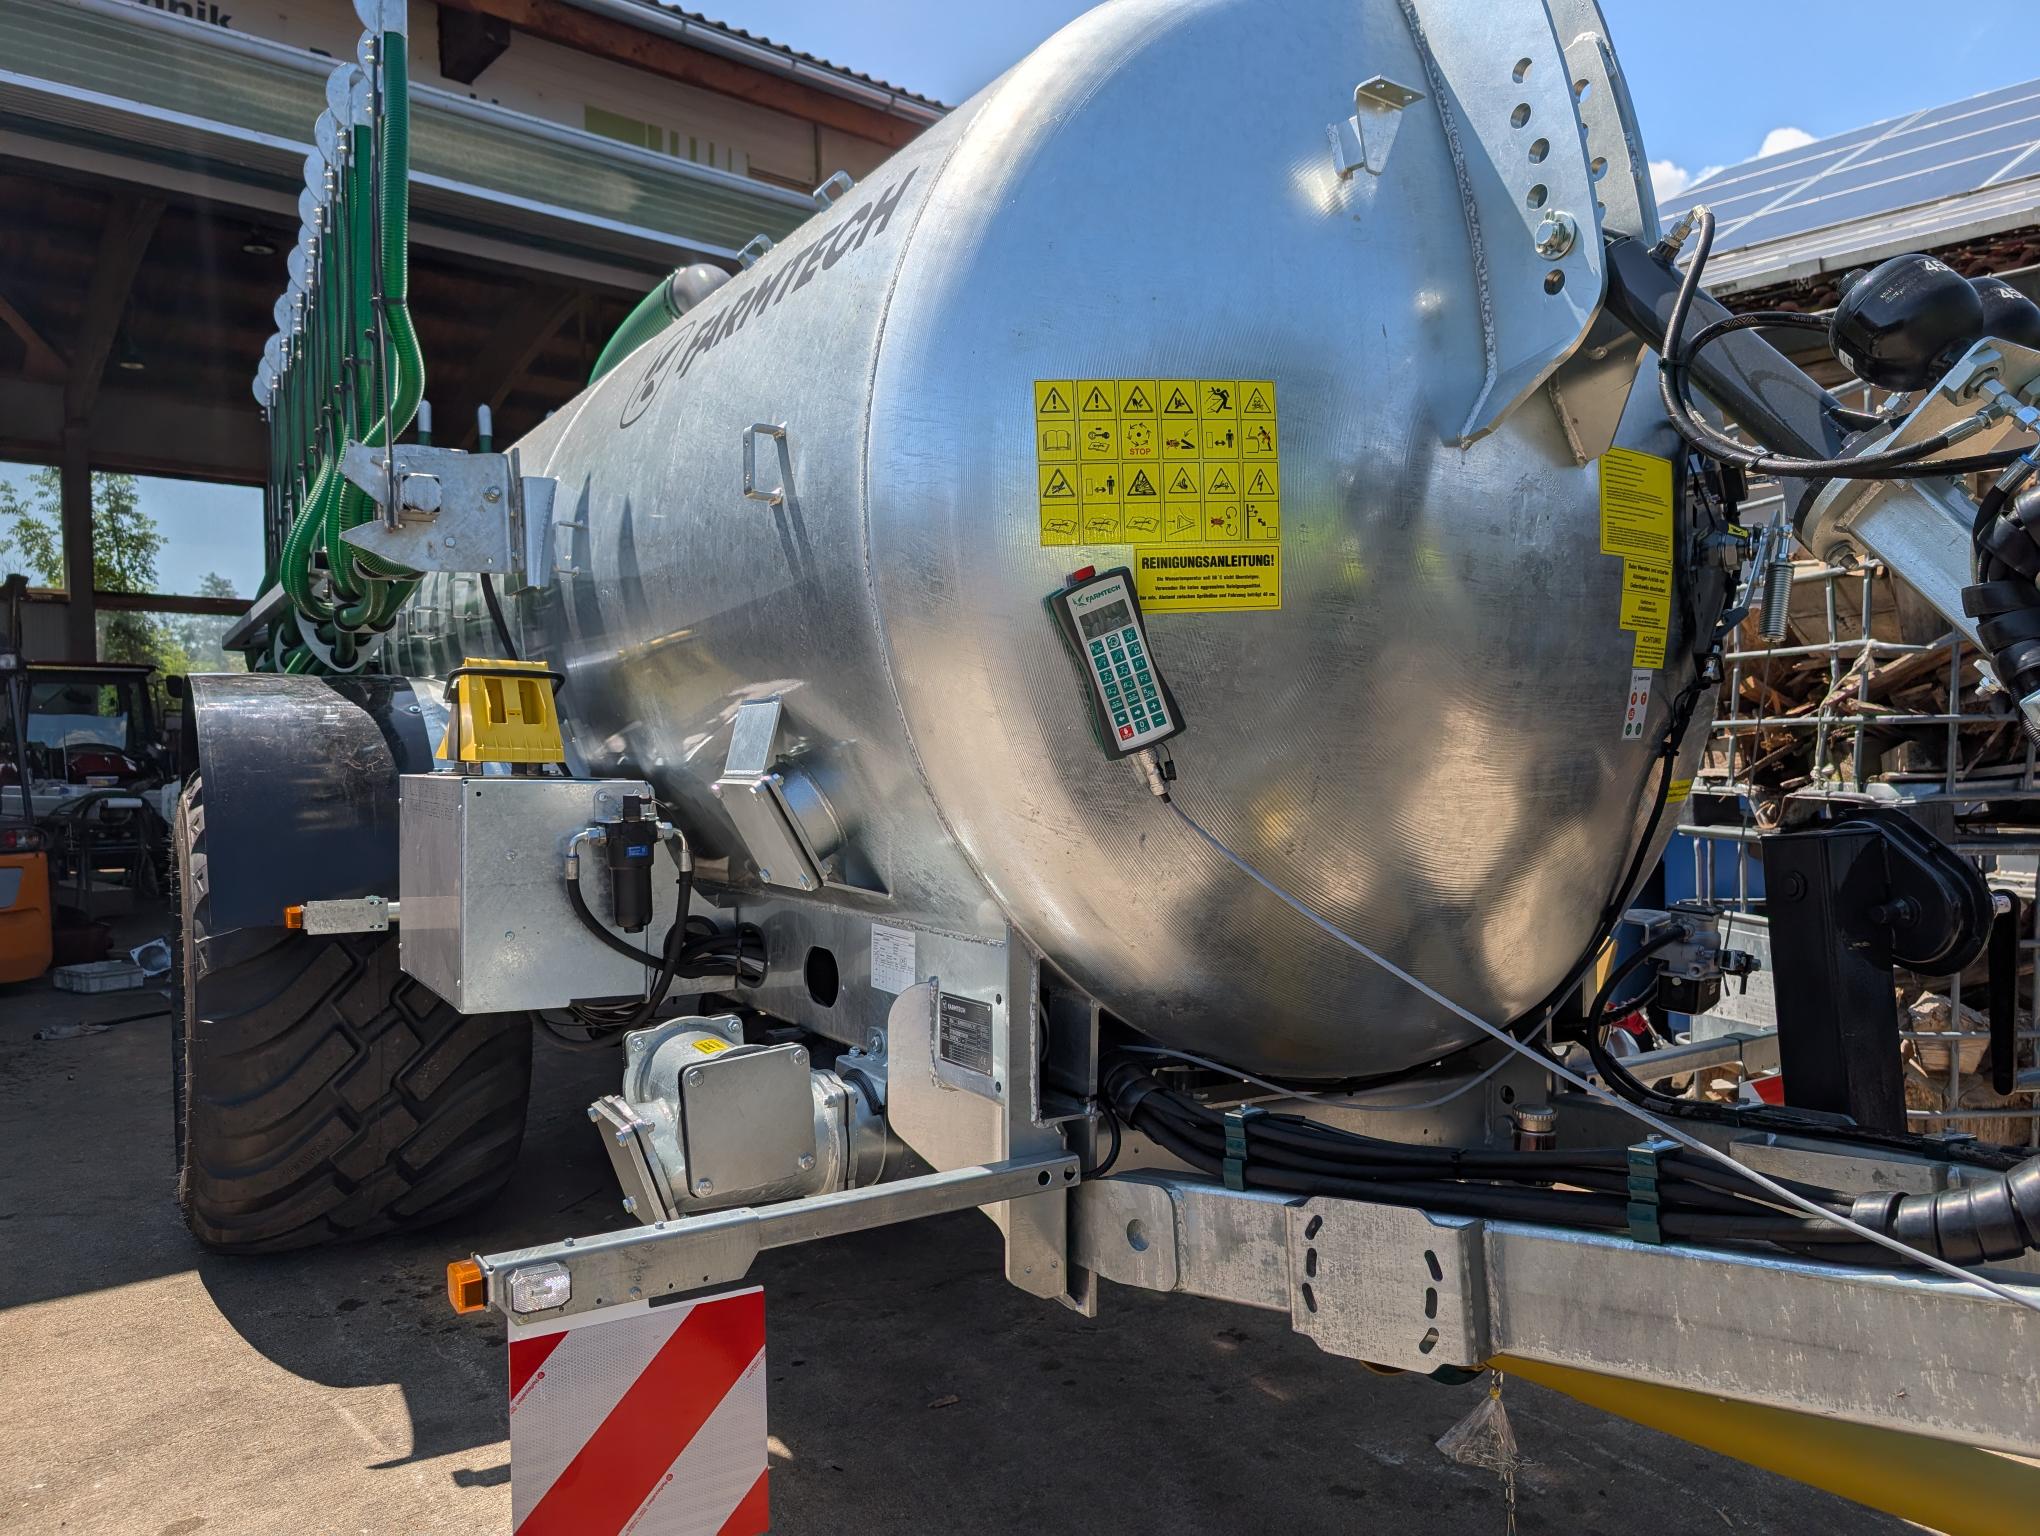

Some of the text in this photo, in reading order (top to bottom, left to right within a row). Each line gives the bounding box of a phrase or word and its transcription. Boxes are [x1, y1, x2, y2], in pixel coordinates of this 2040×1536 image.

[675, 166, 919, 379] FARMTECH
[1142, 555, 1274, 570] REINIGUNGSANLEITUNG!
[1085, 584, 1121, 603] FARMTECH
[1135, 659, 1144, 668] F1
[1139, 674, 1148, 682] F2
